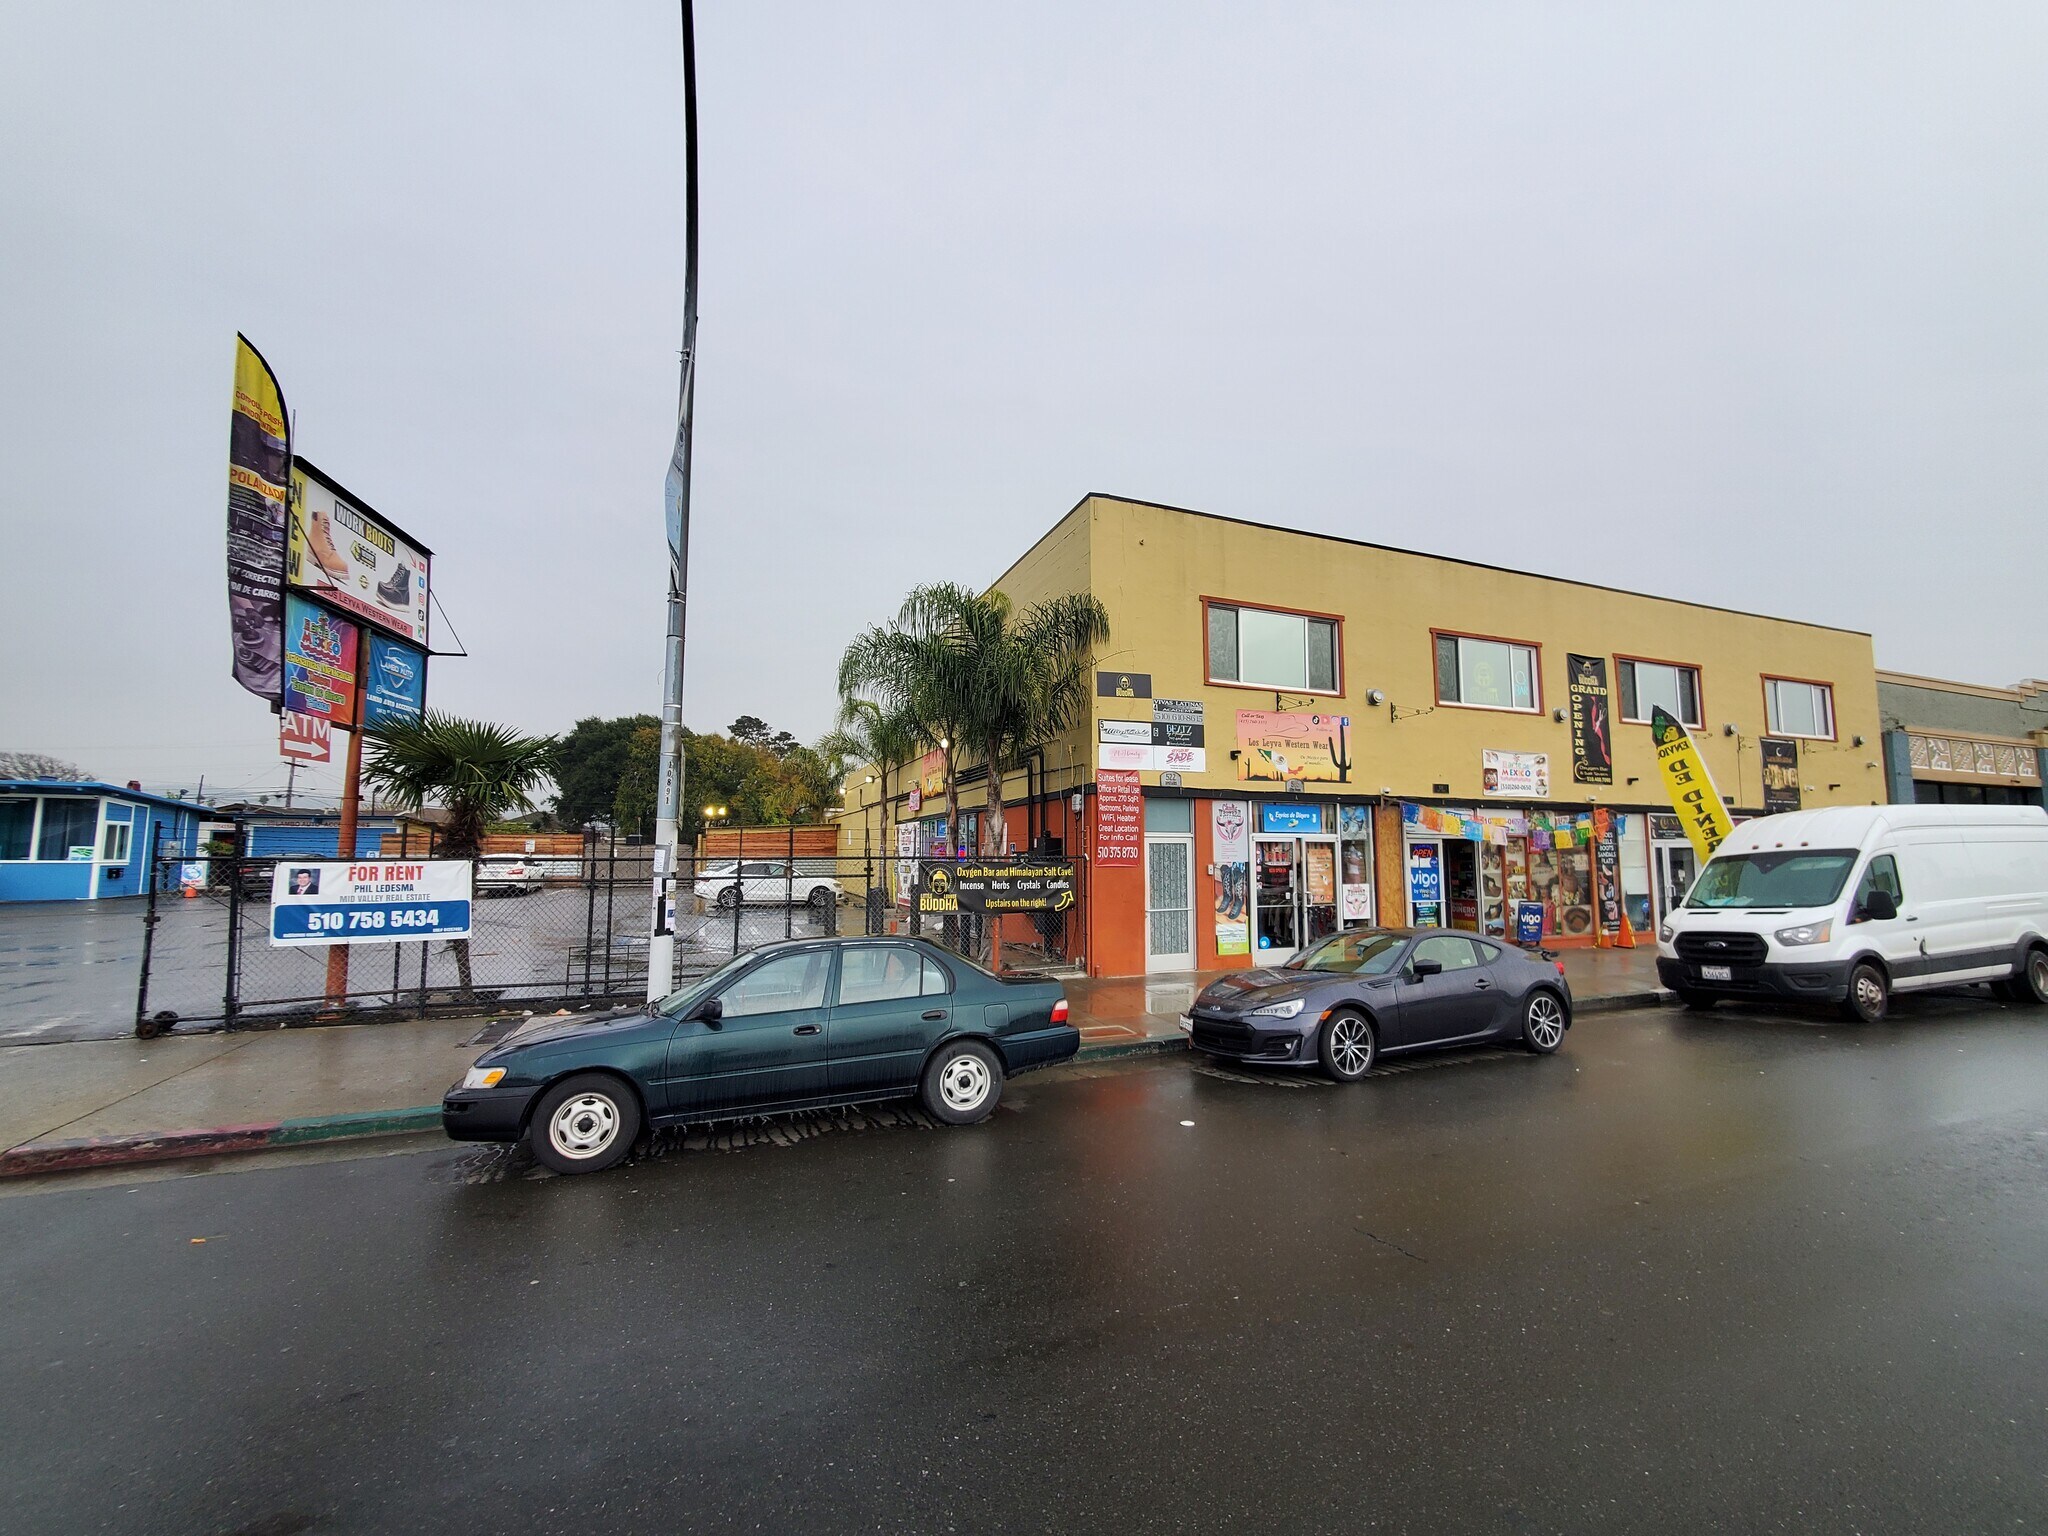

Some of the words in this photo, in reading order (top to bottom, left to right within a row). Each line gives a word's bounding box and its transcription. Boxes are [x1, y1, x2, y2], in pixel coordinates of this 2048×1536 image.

[336, 502, 365, 538] WORK
[366, 523, 395, 555] BOOTS
[339, 590, 361, 611] LEYVA
[362, 604, 392, 626] WESTERN
[392, 620, 408, 634] WEAR
[1570, 684, 1607, 696] GRAND
[281, 711, 331, 742] ATM
[1572, 694, 1586, 756] OPENING
[1249, 738, 1260, 747] Los
[1263, 739, 1282, 749] Leyva
[1285, 739, 1310, 749] Western
[1313, 741, 1329, 750] Wear
[1166, 752, 1195, 764] SADE
[1098, 774, 1116, 782] Suites
[1116, 774, 1124, 782] for
[1124, 775, 1139, 783] lease
[1502, 769, 1531, 777] MEXICO
[1098, 785, 1113, 793] Office
[1118, 786, 1131, 794] Retail
[1131, 786, 1140, 794] Use
[1099, 795, 1118, 803] Approx.
[1128, 795, 1139, 803] SqFt
[1123, 805, 1140, 814] Parking
[1101, 814, 1116, 822] WiFi,
[1117, 814, 1137, 822] Heater
[1099, 824, 1114, 832] Great
[1114, 824, 1139, 833] Location
[1098, 847, 1109, 858] 510
[1110, 847, 1121, 858] 375
[1122, 847, 1138, 859] 8730
[1413, 849, 1434, 858] OPEN
[348, 866, 379, 882] FOR
[385, 865, 424, 882] RENT
[957, 867, 983, 879] Oxygen
[983, 867, 995, 877] Bar
[995, 867, 1009, 877] and
[1010, 867, 1043, 878] Himalayan
[1044, 867, 1057, 876] Salt
[1057, 866, 1074, 876] Cave!
[960, 881, 985, 890] Incense
[992, 881, 1011, 890] Herbs
[1017, 880, 1041, 891] Crystals
[1046, 880, 1070, 890] Candles
[1411, 871, 1438, 888] vigo
[354, 885, 374, 893] PHIL
[376, 884, 415, 893] LEDESMA
[340, 895, 356, 903] MID
[358, 895, 384, 903] VALLEY
[386, 894, 404, 902] REAL
[406, 893, 431, 902] ESTATE
[985, 898, 1011, 909] Upstairs
[1020, 898, 1030, 907] the
[1031, 898, 1047, 908] right!
[920, 898, 959, 911] BUDDHA
[308, 912, 344, 930] 510
[349, 911, 386, 929] 758
[390, 910, 440, 927] 5434
[1521, 912, 1541, 925] vigo
